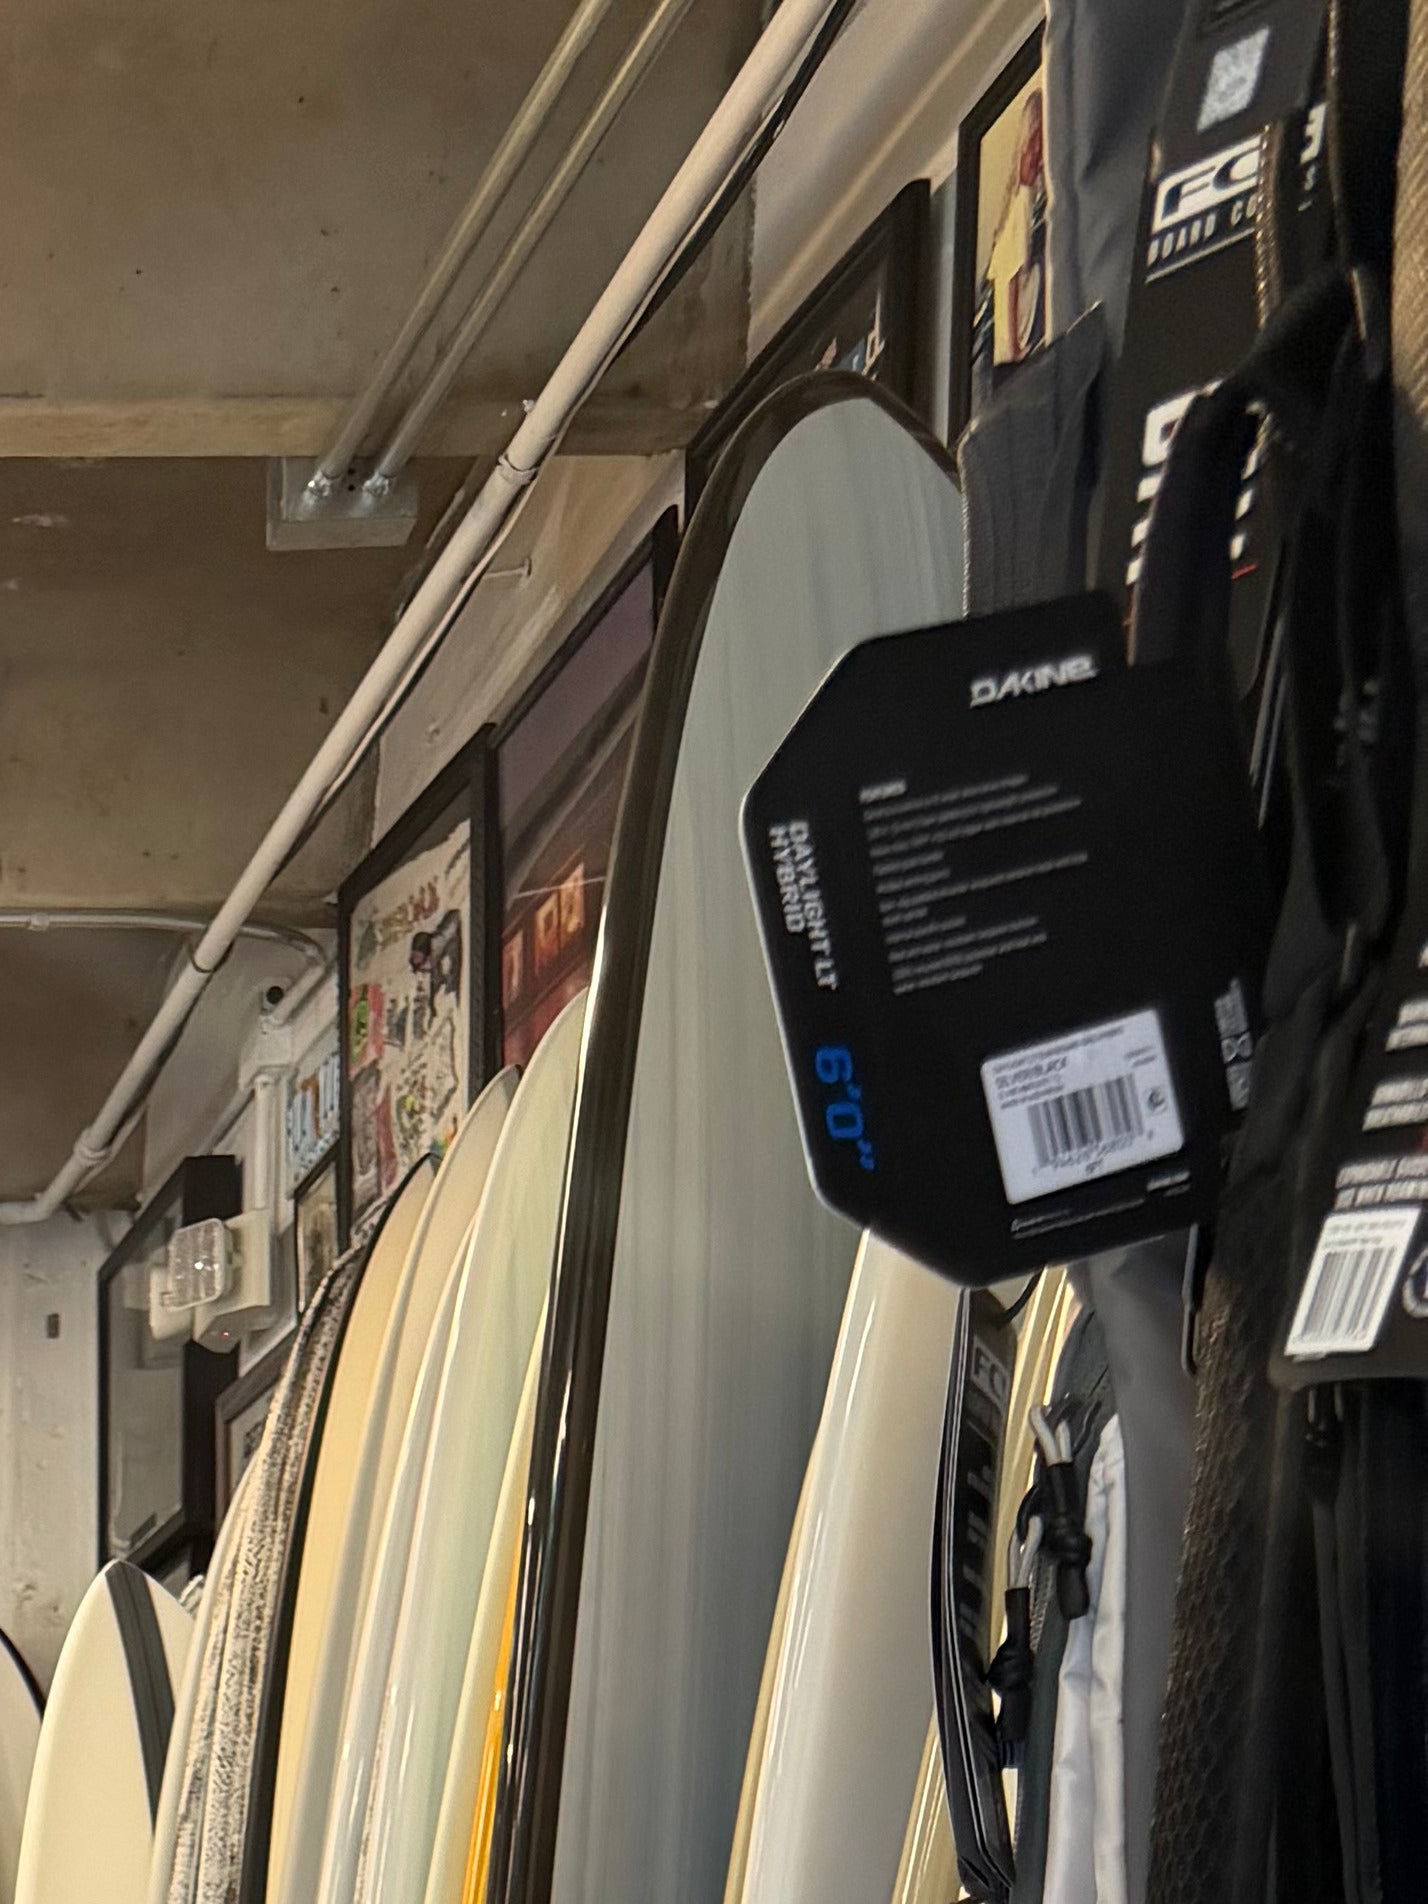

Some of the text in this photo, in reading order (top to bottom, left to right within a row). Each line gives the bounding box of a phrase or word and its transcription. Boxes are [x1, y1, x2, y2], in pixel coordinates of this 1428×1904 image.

[1162, 146, 1261, 220] FC
[970, 653, 1100, 709] DAKINE
[769, 824, 805, 933] HYBRID
[789, 820, 840, 992] DAYLIGHT LT
